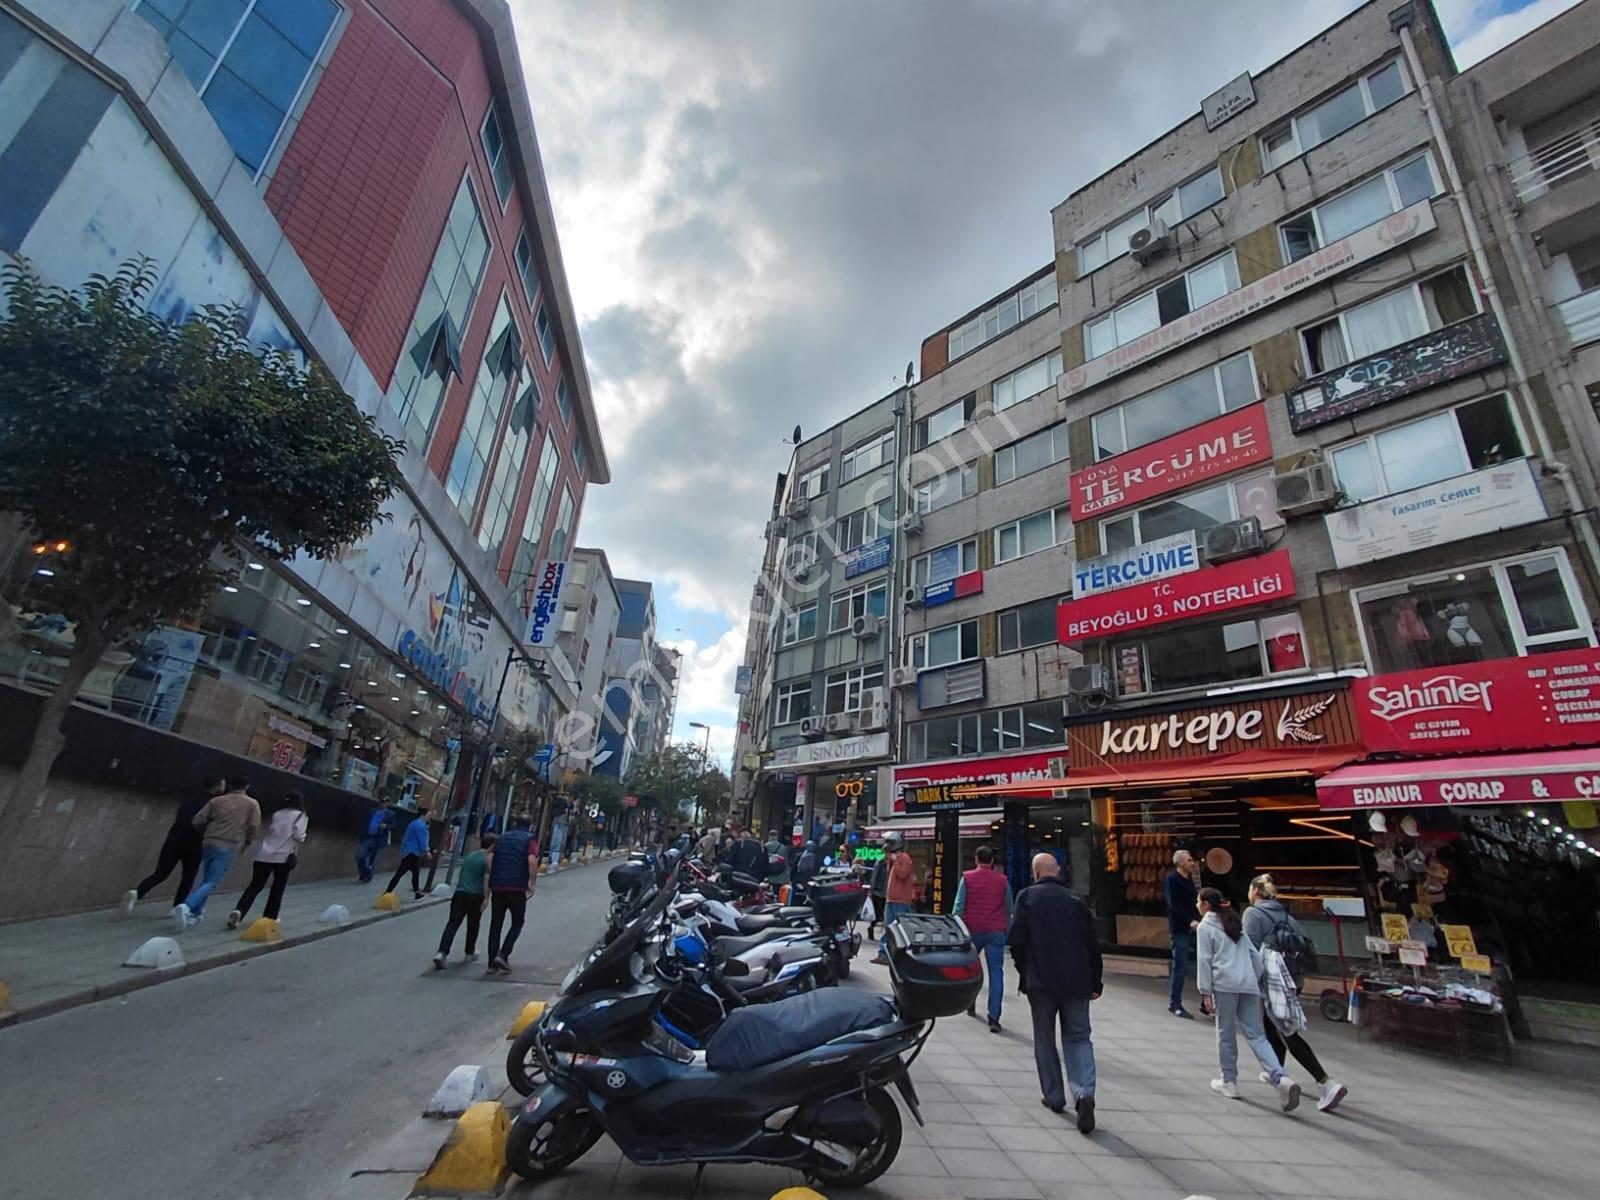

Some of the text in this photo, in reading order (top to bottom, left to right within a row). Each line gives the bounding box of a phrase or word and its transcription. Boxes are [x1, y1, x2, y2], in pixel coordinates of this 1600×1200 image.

[1080, 426, 1256, 501] TERCÜME
[1076, 544, 1195, 592] TERCÜME
[1151, 583, 1175, 598] T.C.
[530, 562, 558, 643] englishbox
[1068, 606, 1148, 636] BEYOĞLU
[1153, 603, 1169, 618] 3.
[1173, 573, 1283, 613] NOTERLİĞİ
[1100, 709, 1263, 756] kartepe
[916, 787, 942, 804] DARK
[1353, 784, 1423, 806] EDANUR
[1440, 781, 1505, 803] ÇORAP
[1531, 778, 1550, 798] &
[933, 831, 945, 914] INTERNE
